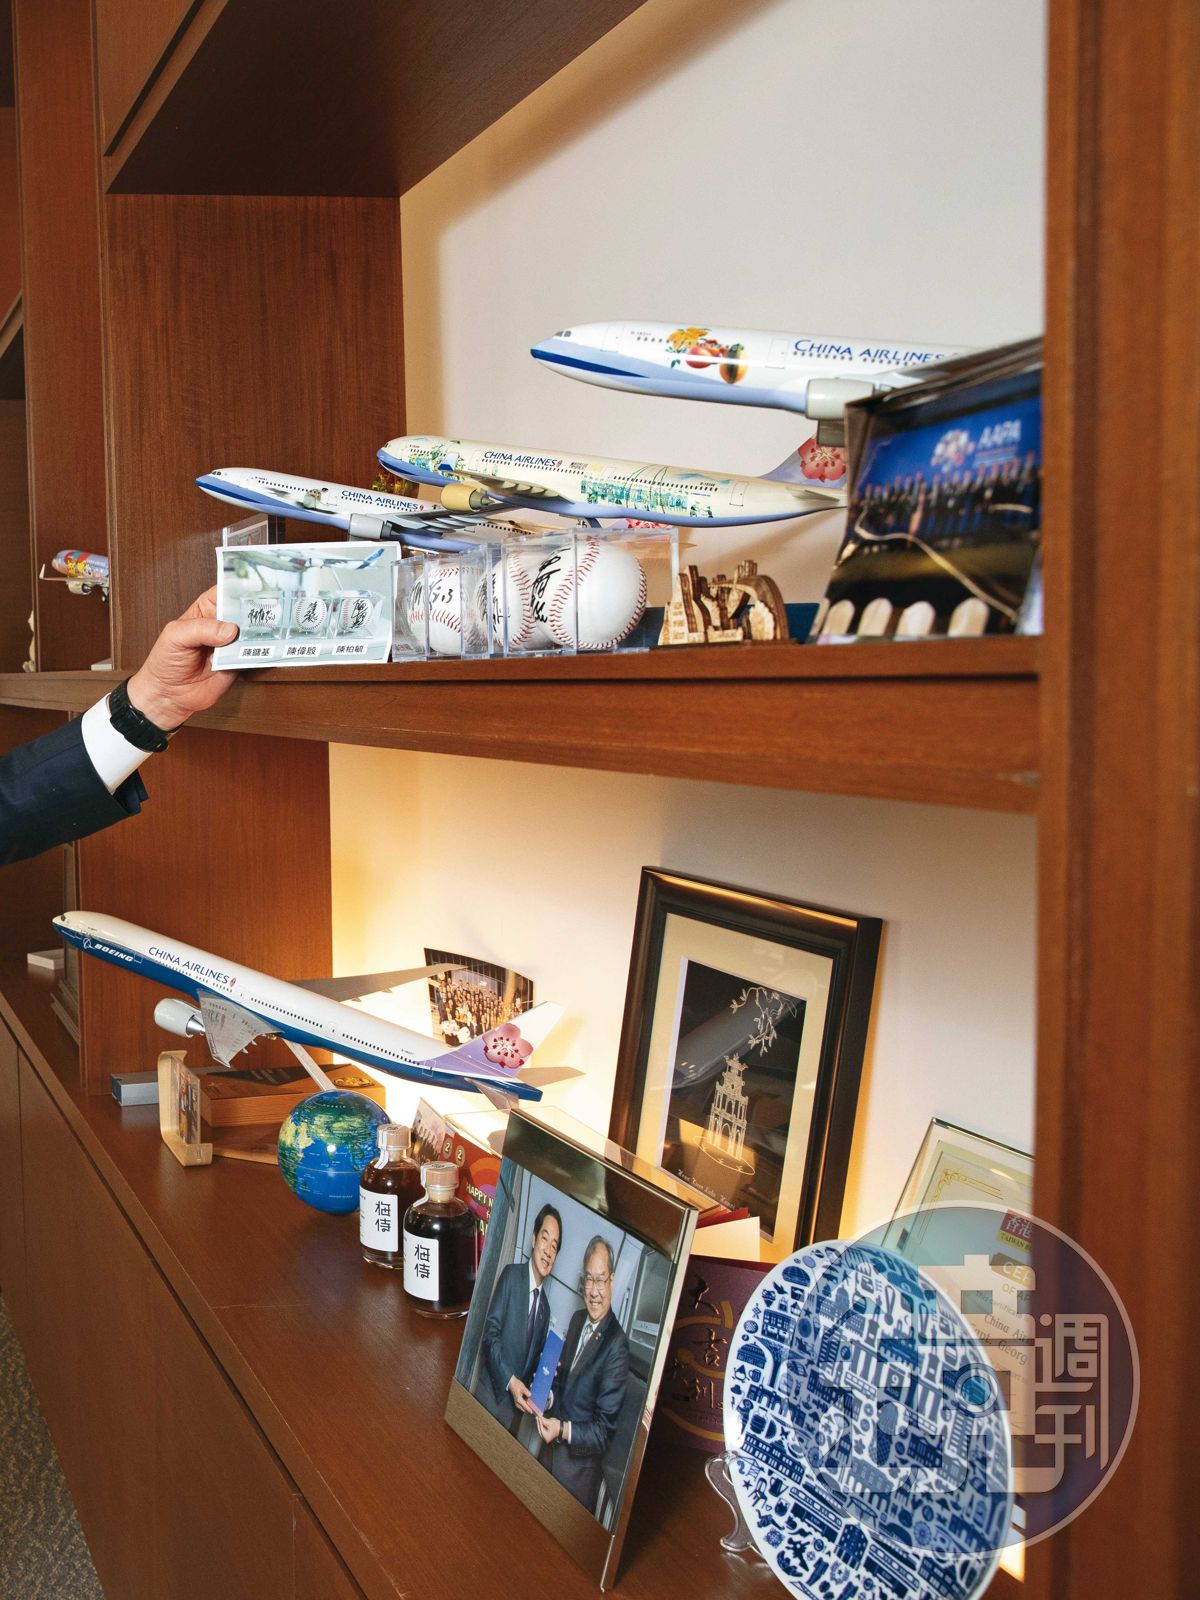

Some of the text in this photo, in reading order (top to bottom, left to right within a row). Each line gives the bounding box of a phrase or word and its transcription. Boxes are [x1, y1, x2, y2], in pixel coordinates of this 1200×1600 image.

[794, 339, 852, 356] CHINA
[484, 451, 513, 463] CHINA
[514, 454, 557, 468] AIRLINES
[341, 490, 418, 510] CHINA AIRLINES
[286, 646, 316, 656] 陳偉殷
[93, 943, 134, 963] BOEING
[148, 946, 230, 985] CHINA AIRLINES
[466, 1182, 487, 1204] HAPPY
[1002, 1283, 1016, 1295] OF
[984, 1313, 1010, 1334] China
